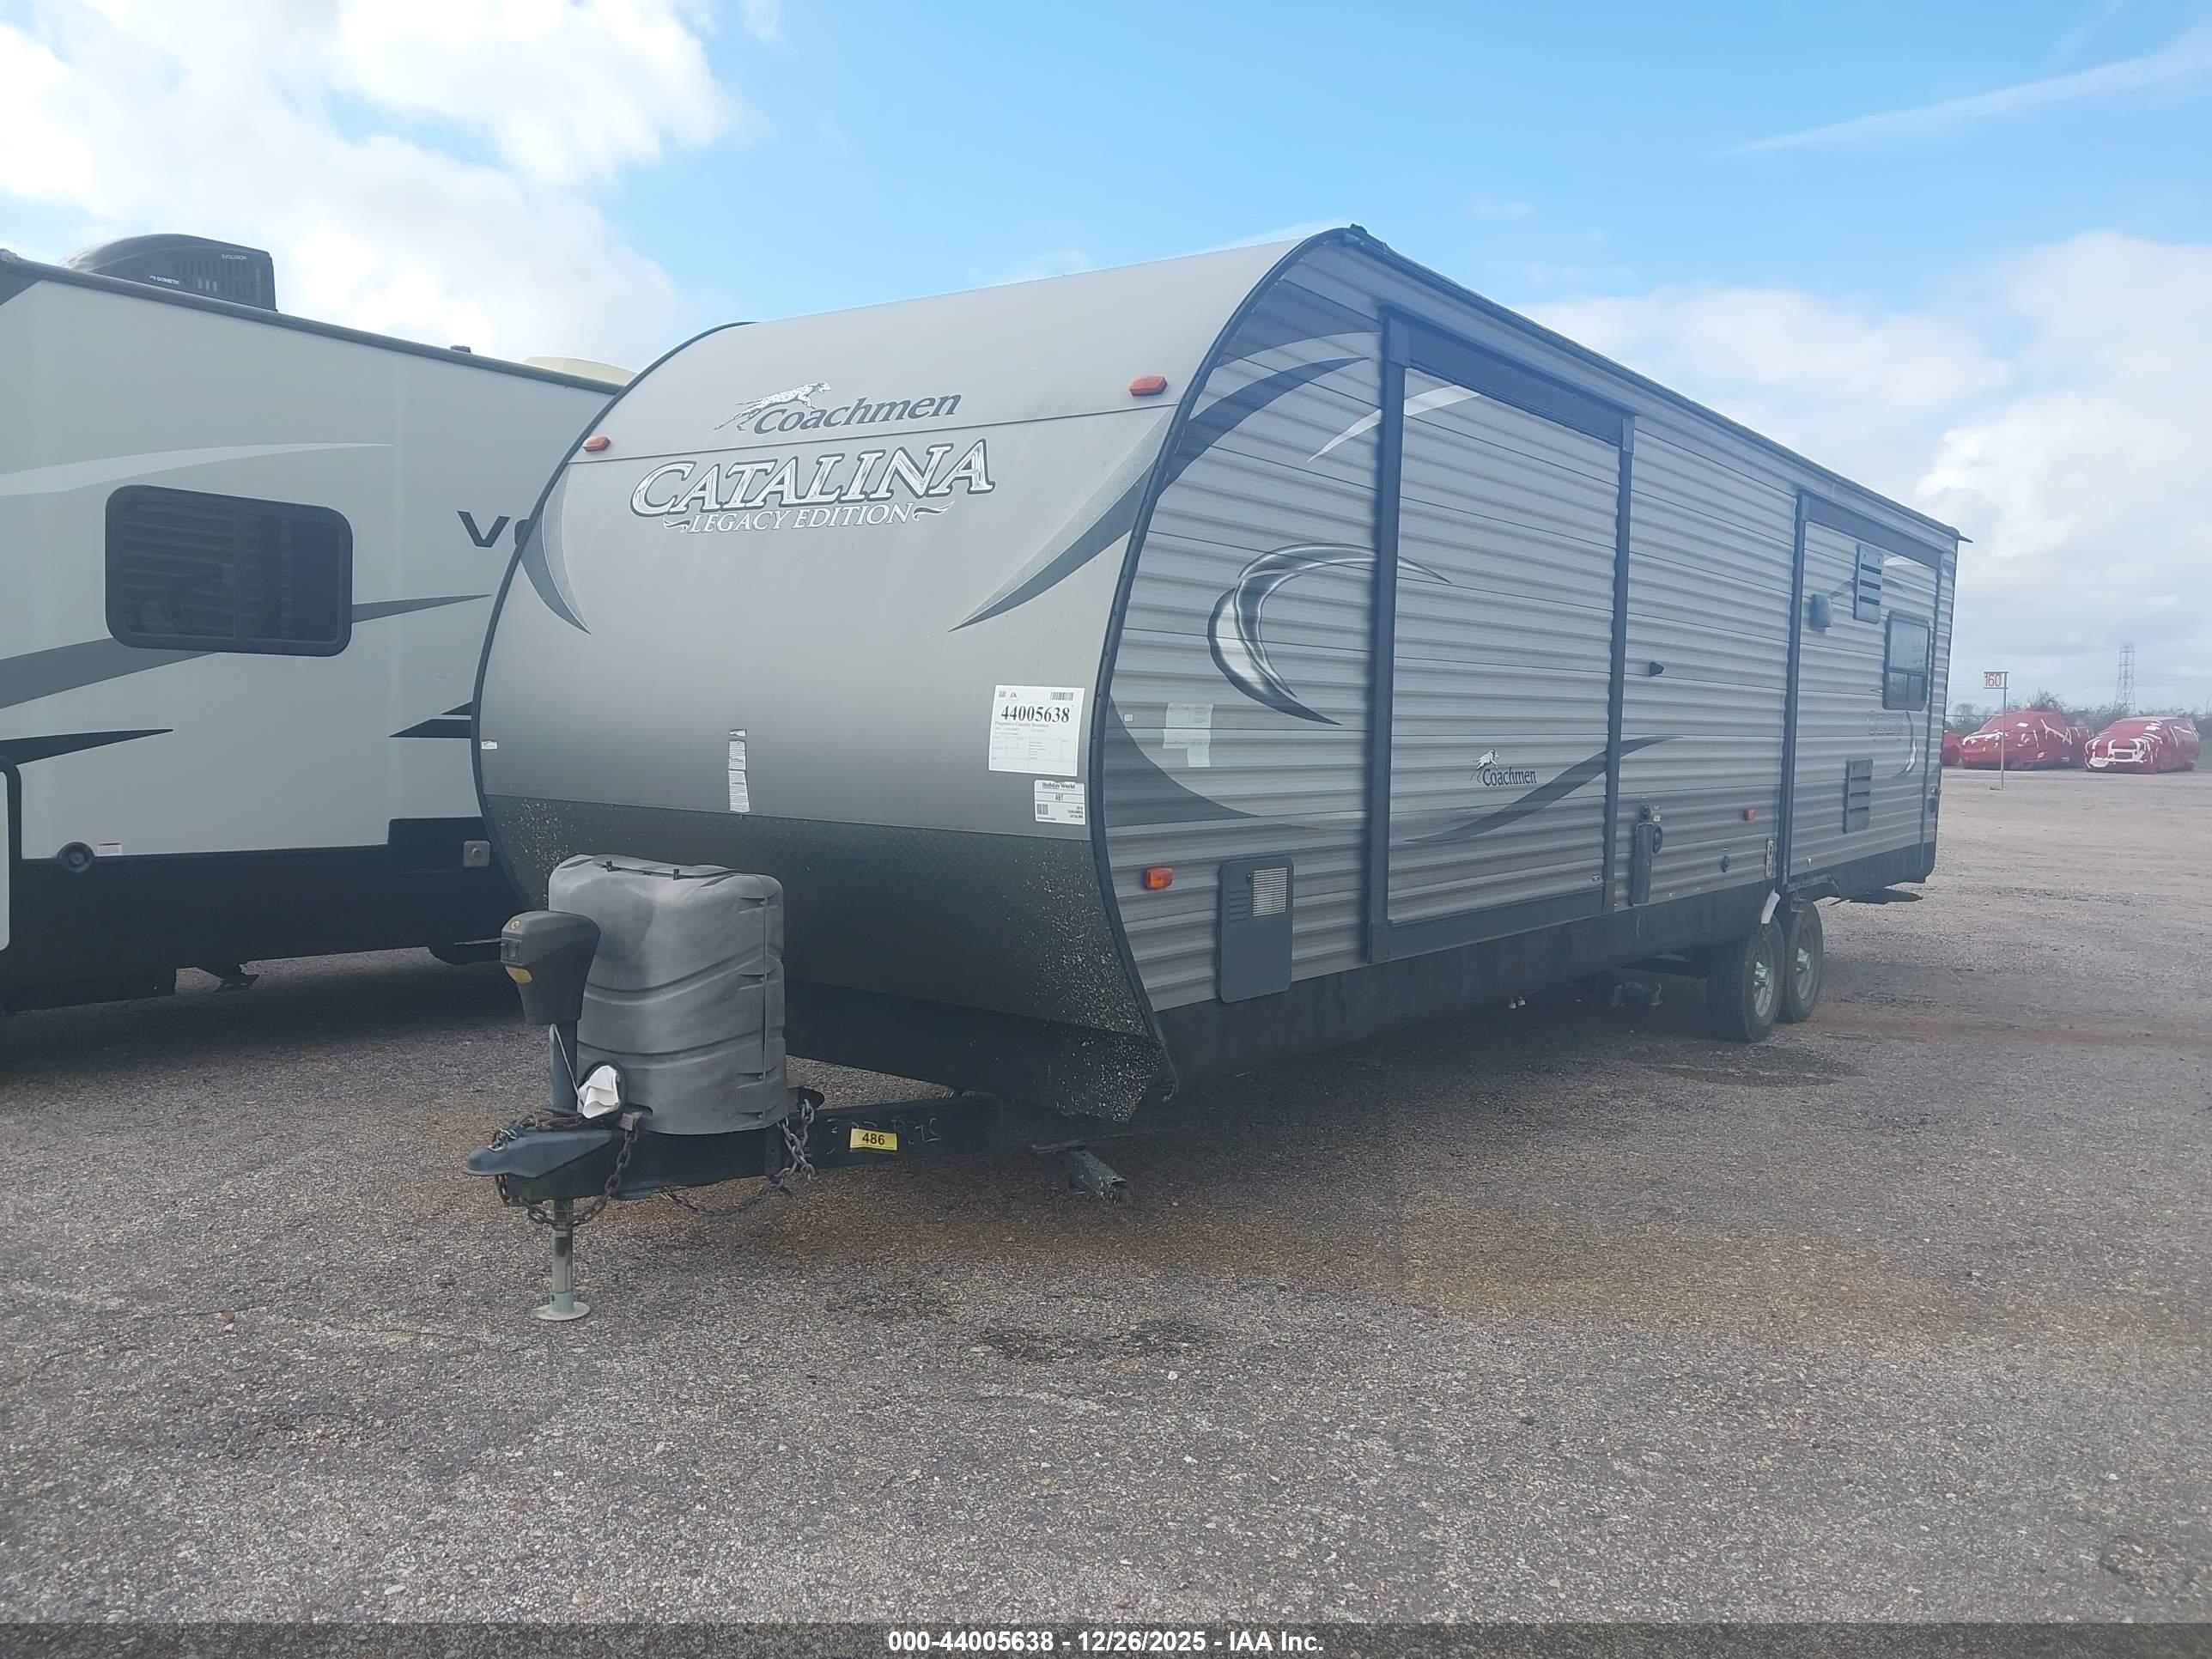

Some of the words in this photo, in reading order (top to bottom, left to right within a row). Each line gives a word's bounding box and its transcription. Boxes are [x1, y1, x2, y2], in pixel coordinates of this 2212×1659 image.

[752, 392, 963, 434] Coachmen
[630, 438, 996, 517] CATALINA
[686, 509, 793, 534] LEGACY
[792, 502, 914, 529] EDITION
[1984, 673, 2002, 687] 160
[1000, 704, 1071, 723] 44005638
[1482, 766, 1537, 787] Coachmen
[861, 1132, 885, 1146] 486
